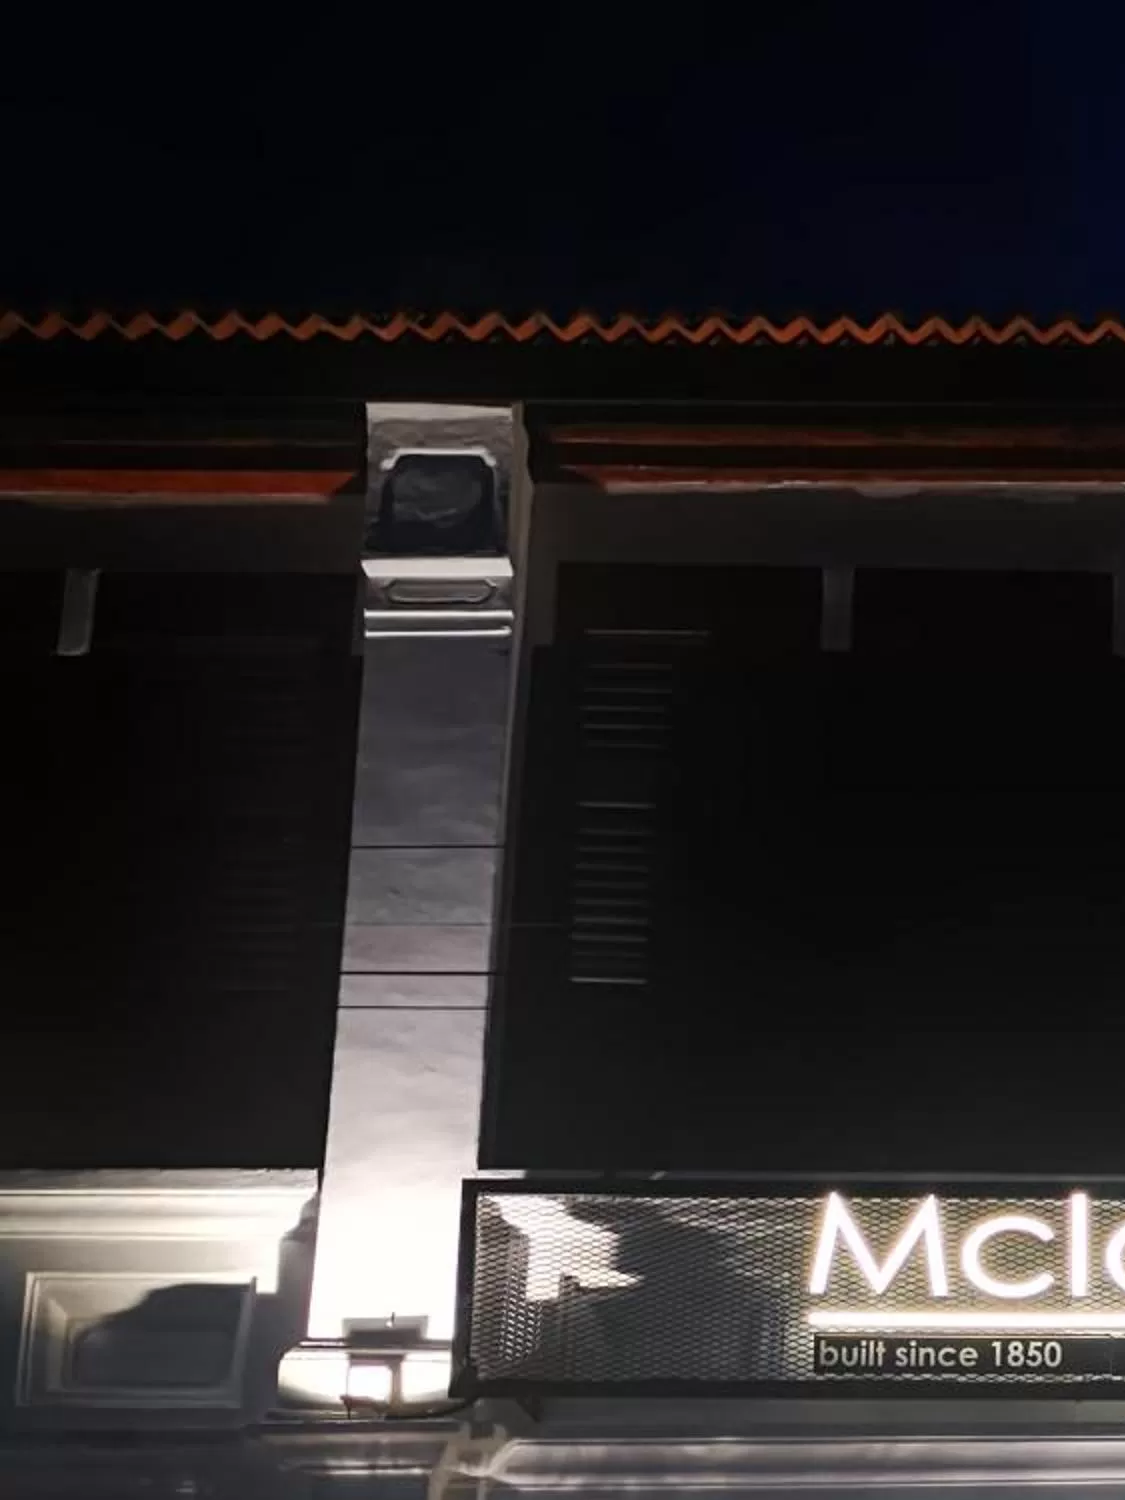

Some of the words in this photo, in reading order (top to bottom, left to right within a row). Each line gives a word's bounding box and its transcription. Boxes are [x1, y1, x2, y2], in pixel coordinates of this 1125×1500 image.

[819, 1340, 885, 1367] built
[895, 1340, 979, 1367] since
[991, 1340, 1063, 1368] 1850
